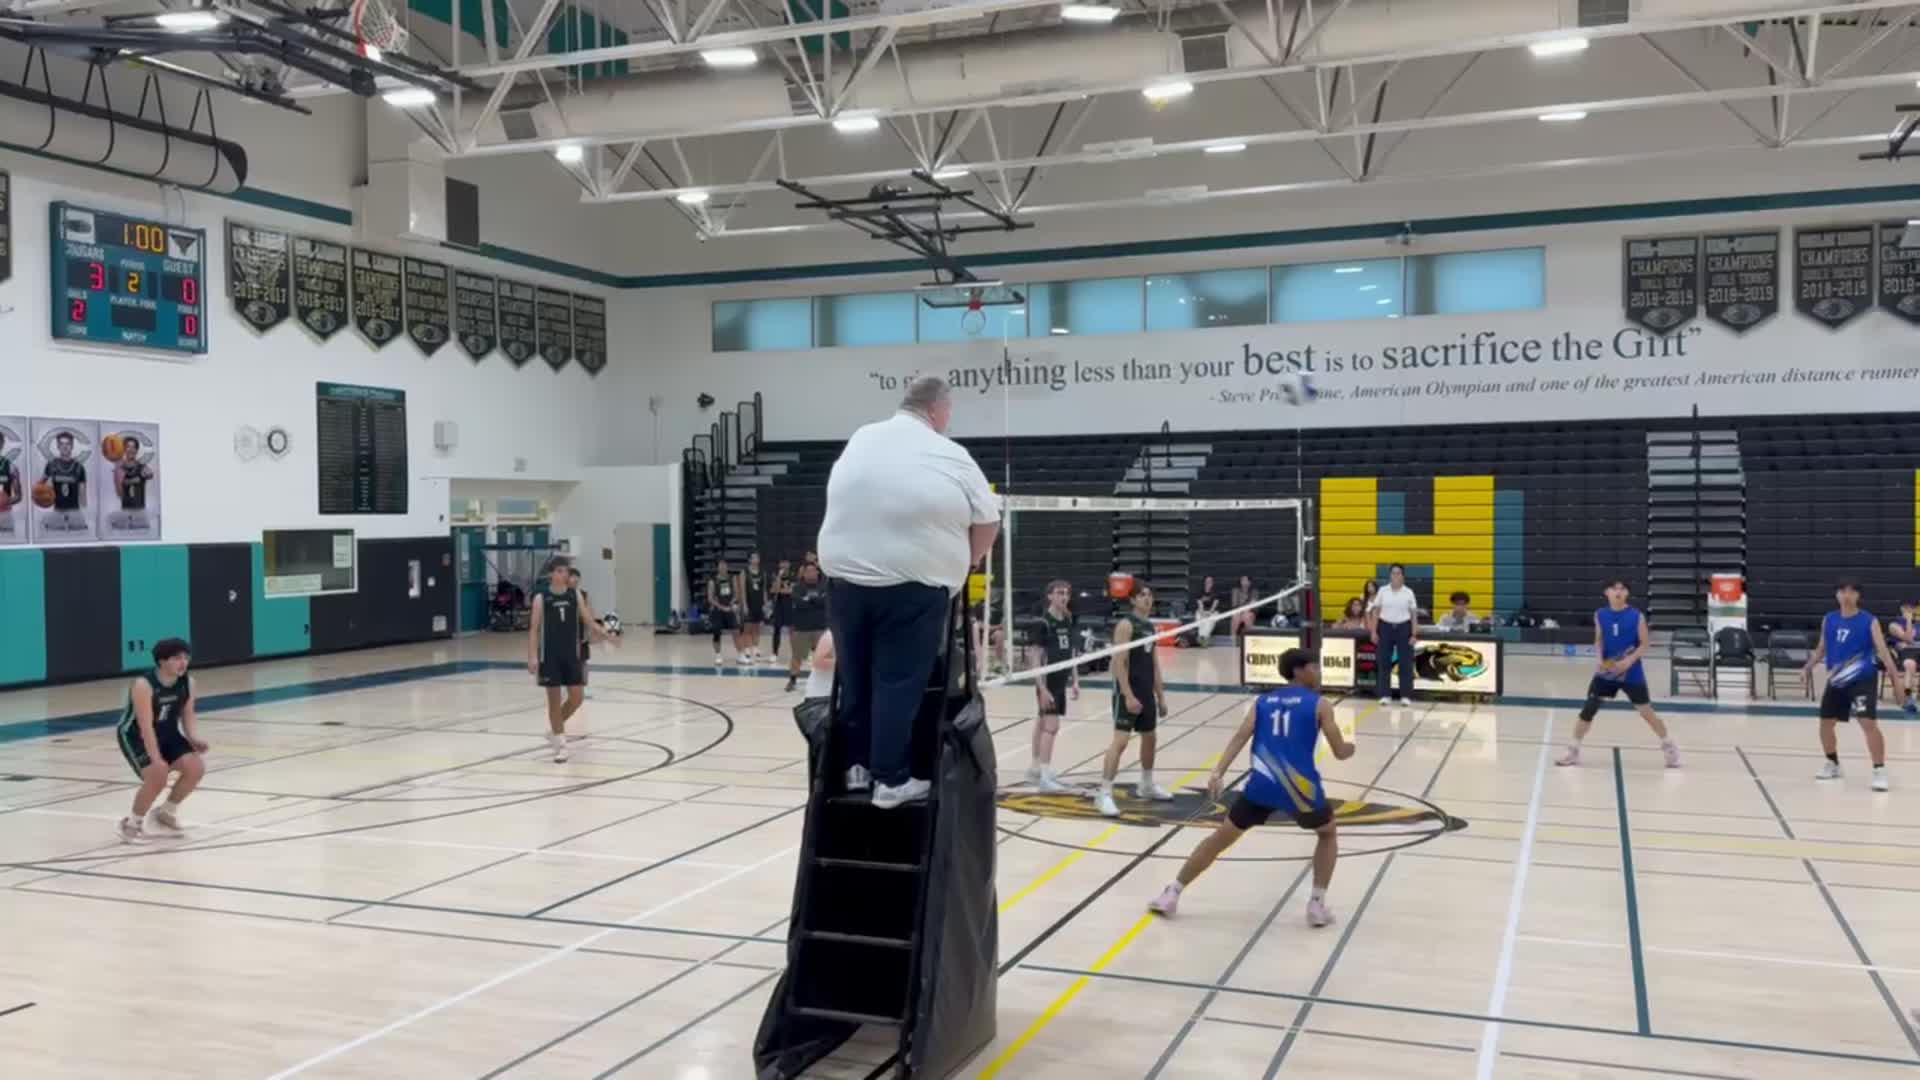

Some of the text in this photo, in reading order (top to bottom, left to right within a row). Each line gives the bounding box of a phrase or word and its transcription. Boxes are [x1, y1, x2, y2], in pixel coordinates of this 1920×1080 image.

[89, 261, 104, 292] 3
[126, 271, 142, 294] 2
[182, 278, 197, 304] 0
[70, 299, 86, 323] 2
[184, 313, 197, 338] 0
[948, 354, 1066, 394] anything
[1074, 360, 1114, 384] less
[1122, 356, 1172, 382] than
[1179, 358, 1235, 384] your
[1242, 341, 1316, 376] best
[1324, 350, 1344, 373] is
[1351, 351, 1374, 371] to
[1382, 330, 1543, 369] sacrifice
[1551, 331, 1603, 362] the
[1350, 381, 1421, 400] American
[1425, 378, 1501, 398] Olympian
[1505, 377, 1536, 393] and
[1541, 380, 1569, 393] one
[1573, 374, 1593, 394] of
[1595, 372, 1620, 390] the
[1623, 372, 1690, 392] greatest
[1694, 369, 1777, 387] American
[1781, 366, 1856, 384] distance
[1320, 475, 1494, 622] H
[1836, 627, 1851, 643] 17
[1269, 708, 1291, 738] 11
